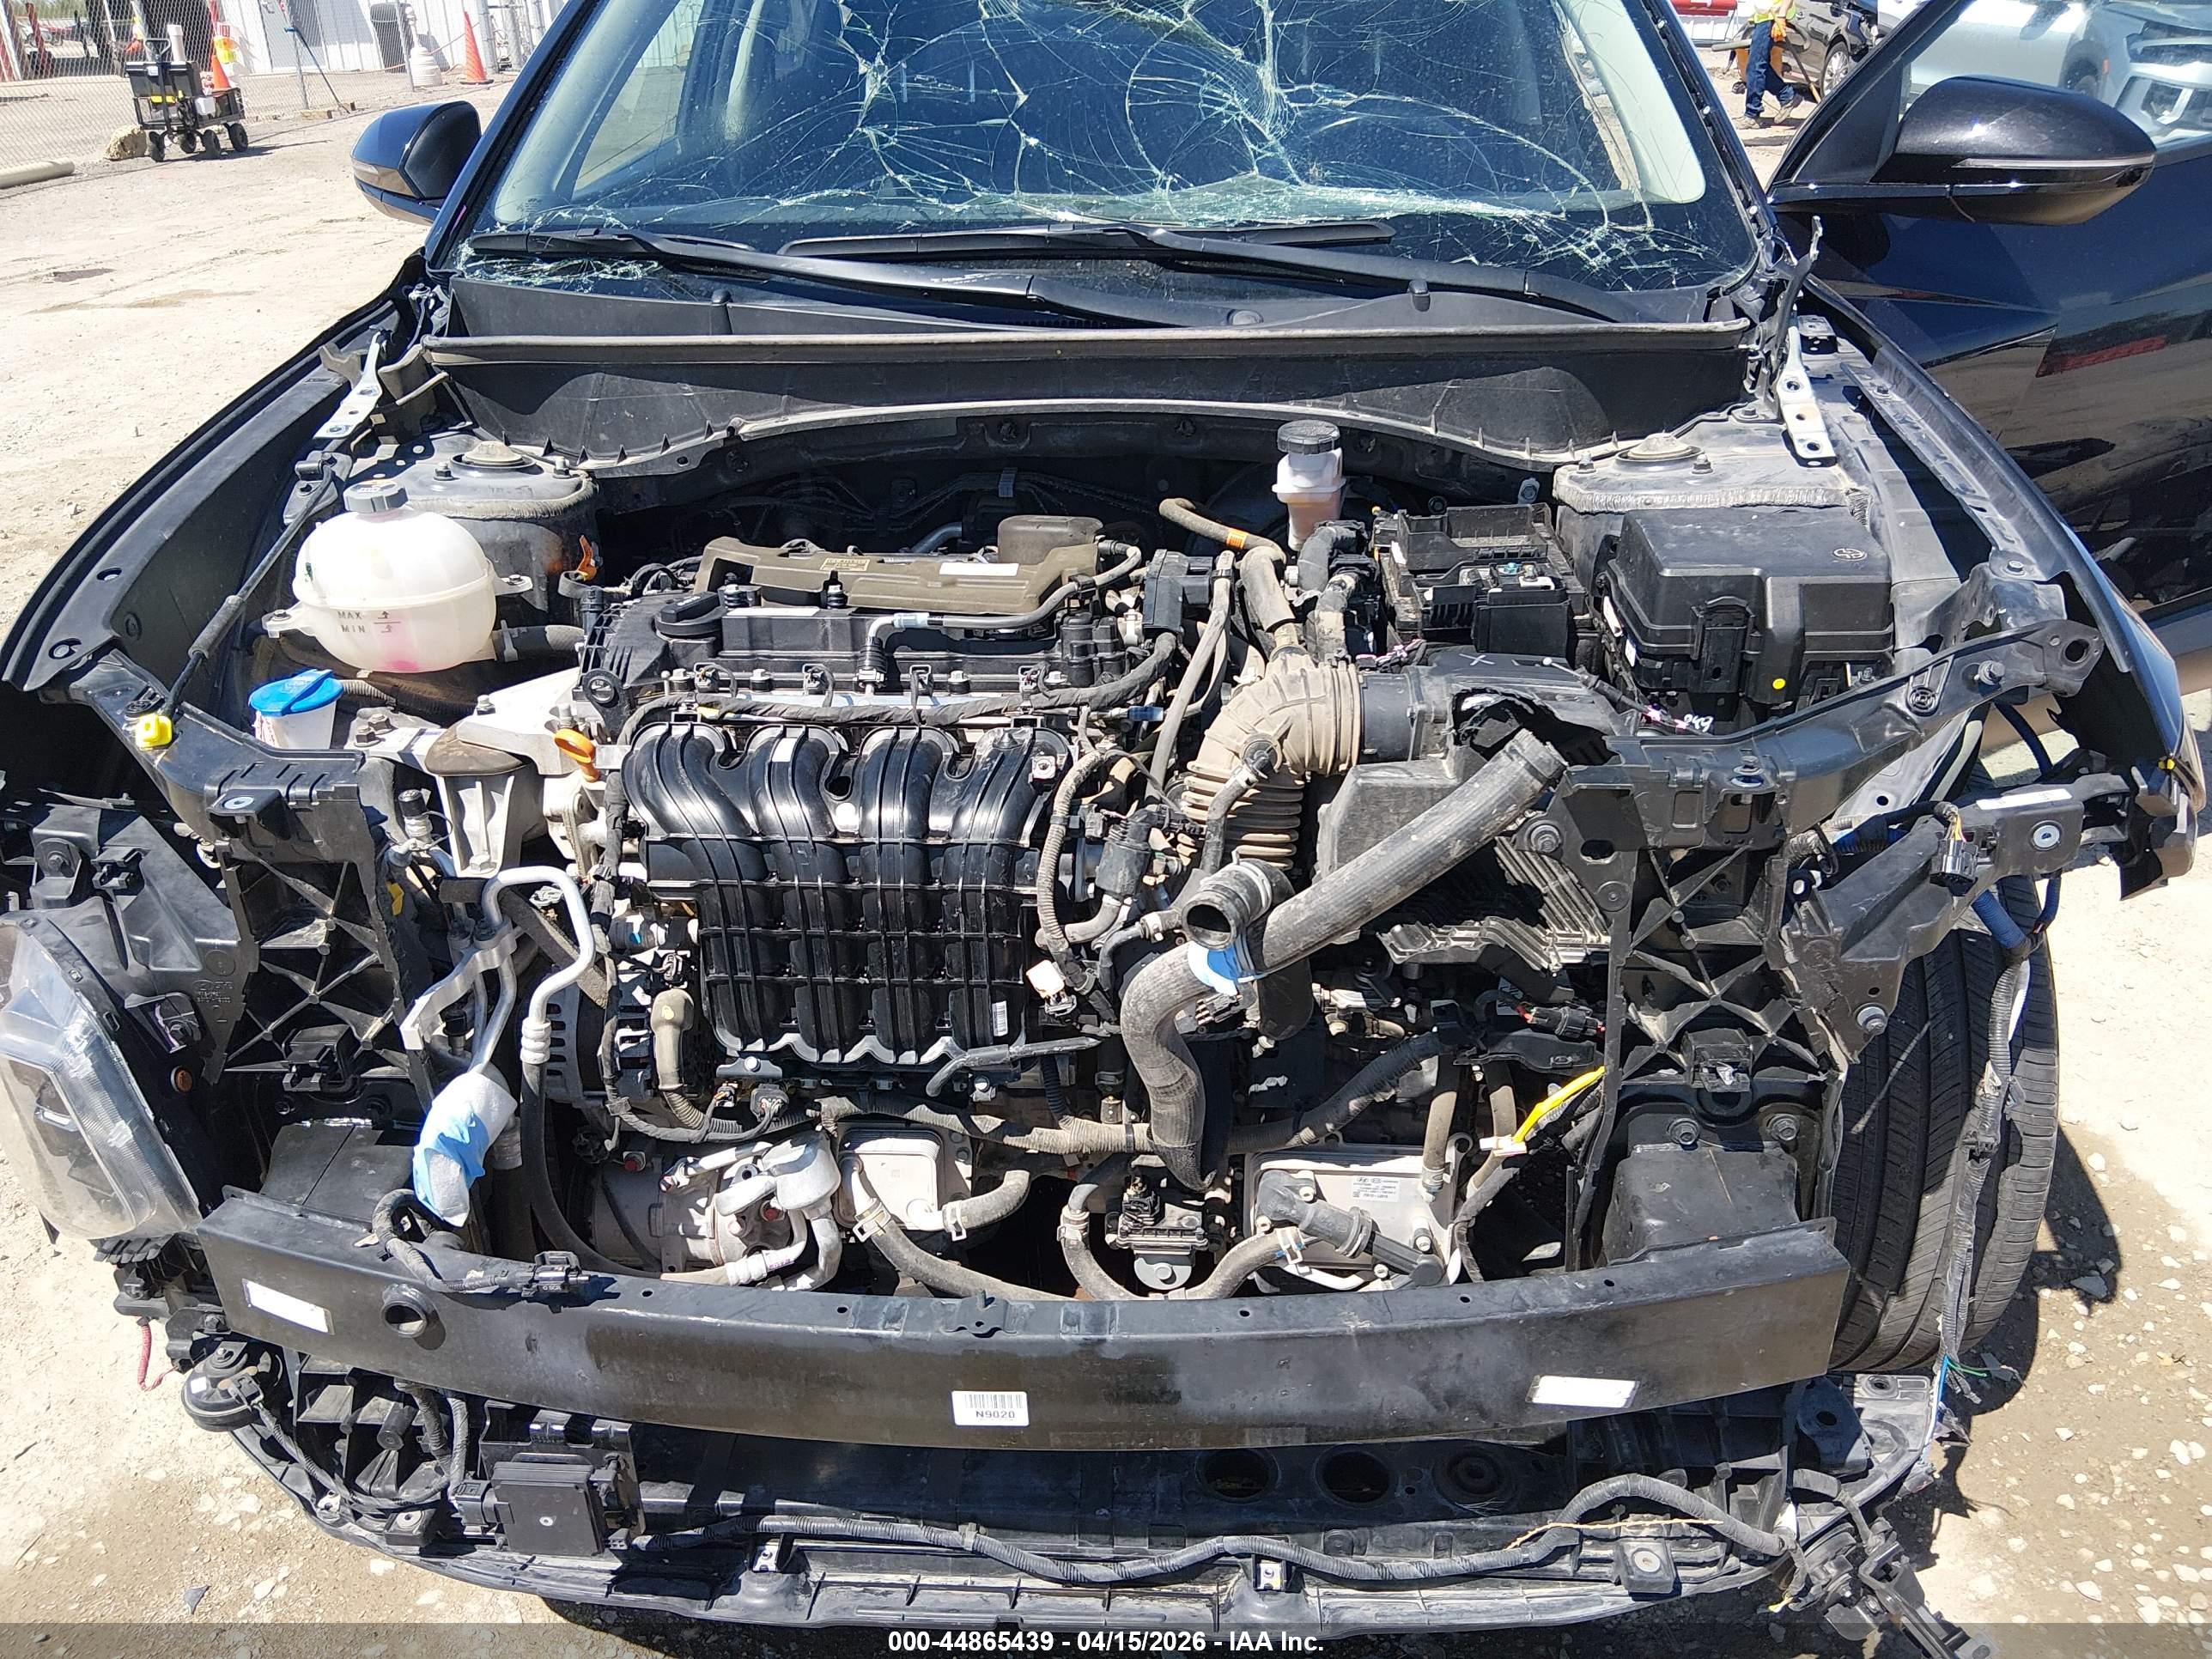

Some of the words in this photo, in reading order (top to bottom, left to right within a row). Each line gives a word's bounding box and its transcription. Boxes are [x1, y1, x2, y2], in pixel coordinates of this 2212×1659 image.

[337, 611, 362, 619] MAX
[341, 624, 366, 633] MIN
[975, 1410, 1016, 1419] N9020
